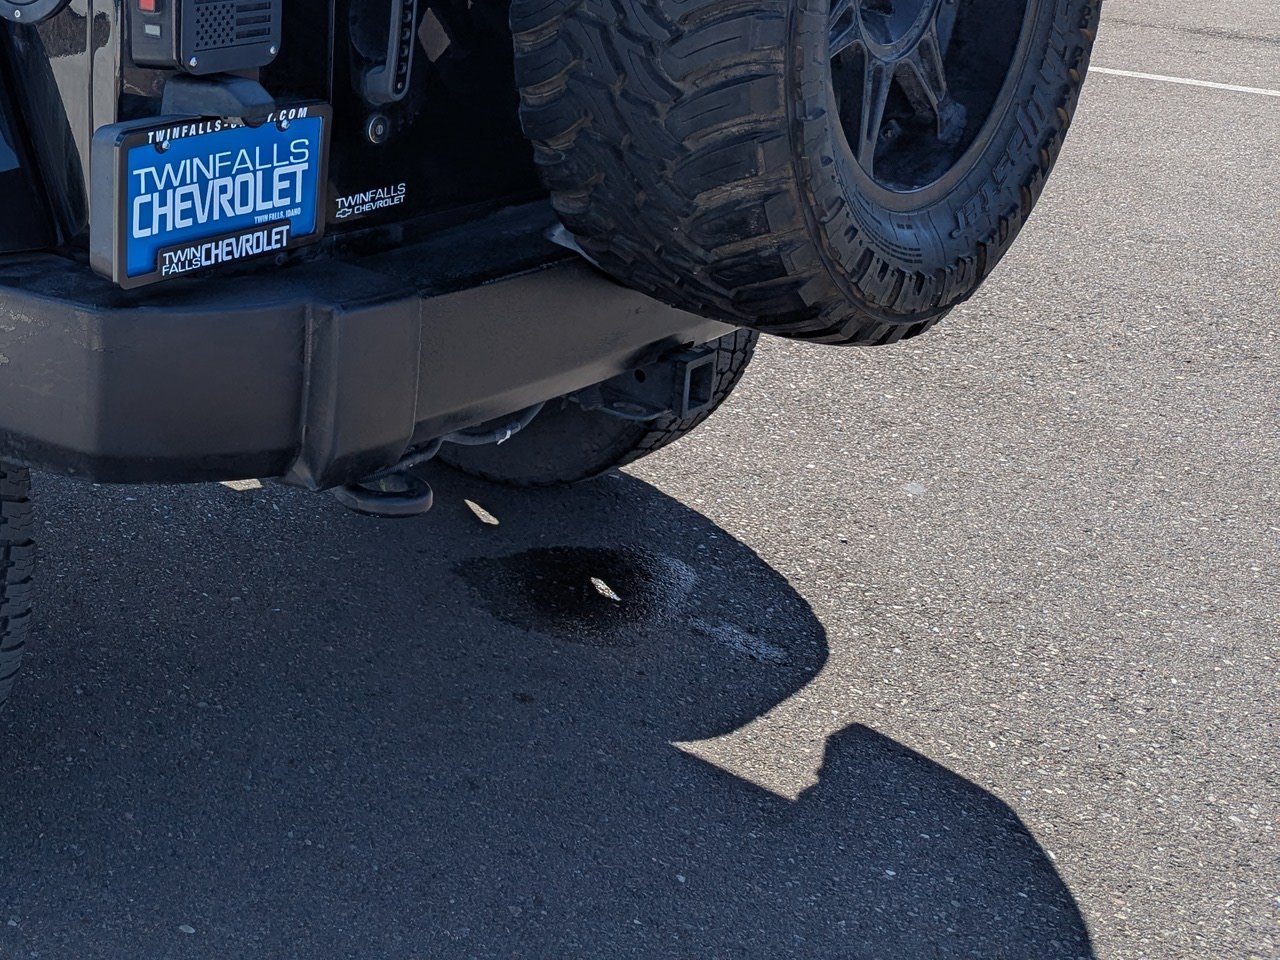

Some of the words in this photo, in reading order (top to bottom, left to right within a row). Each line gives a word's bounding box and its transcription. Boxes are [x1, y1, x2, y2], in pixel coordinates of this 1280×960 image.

[133, 139, 309, 194] TWINFALLS
[132, 163, 309, 238] CHEVROLET
[336, 183, 406, 209] TWINFALLS
[354, 194, 406, 214] CHEVROLET
[163, 246, 200, 264] TWIN
[201, 225, 290, 267] CHEVROLET
[162, 258, 200, 276] FALLS
